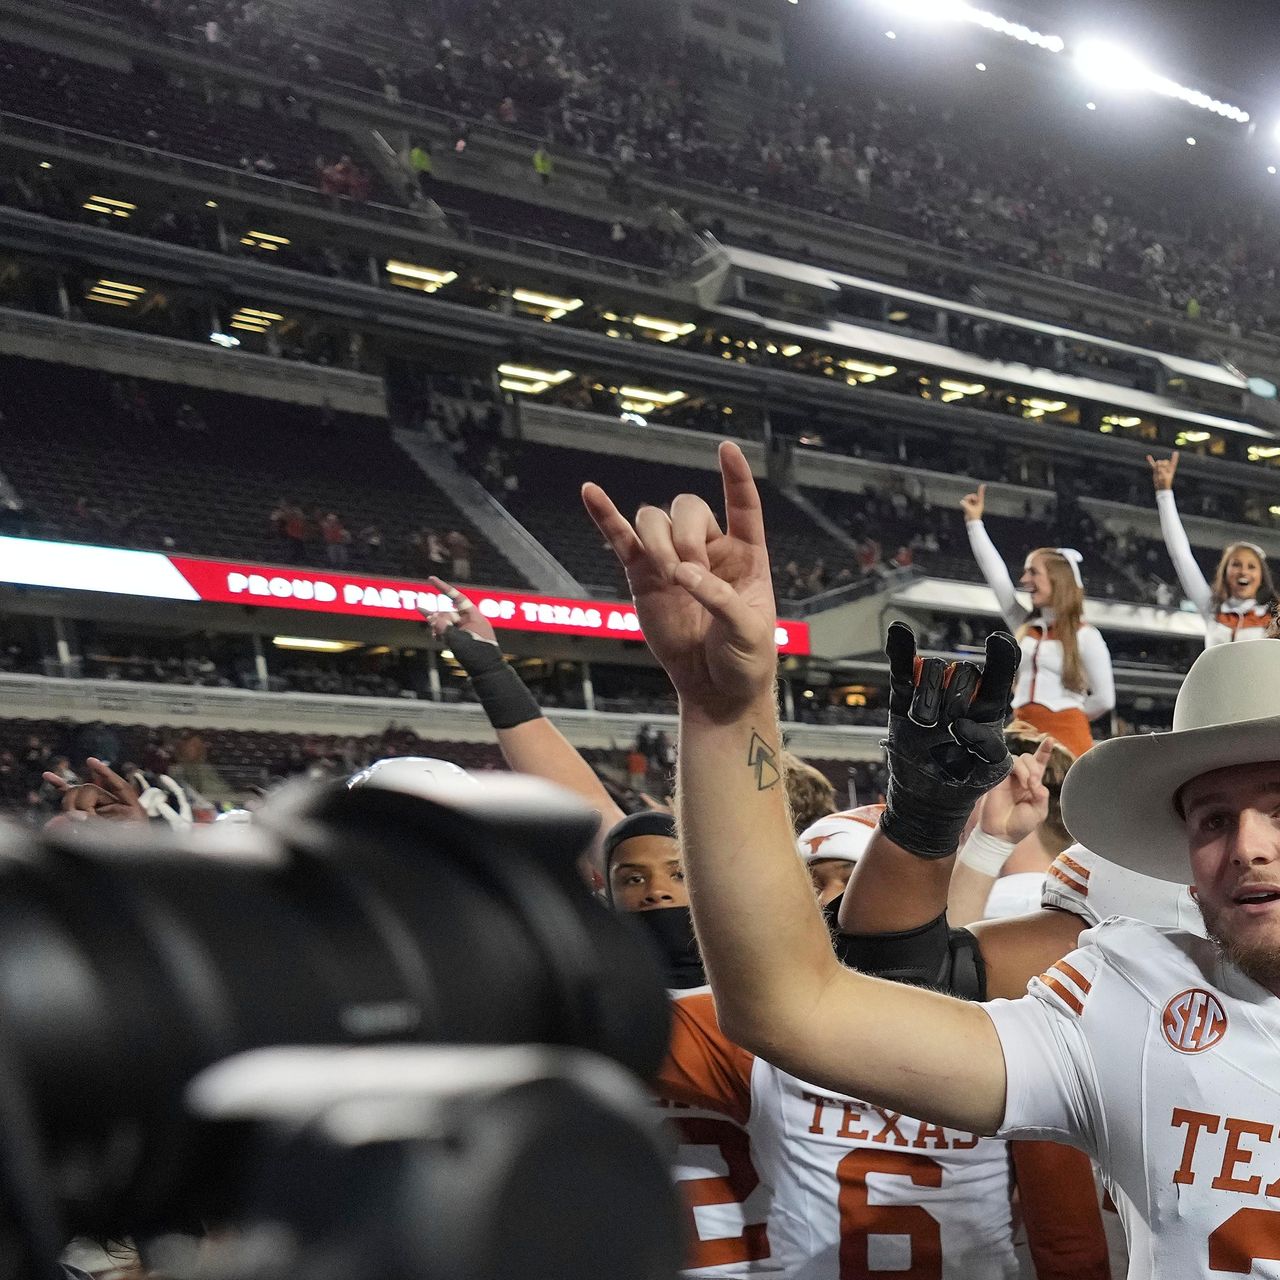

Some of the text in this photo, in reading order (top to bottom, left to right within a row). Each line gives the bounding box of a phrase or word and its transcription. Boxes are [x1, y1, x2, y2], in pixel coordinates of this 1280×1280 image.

[227, 572, 337, 602] PROUD
[343, 584, 456, 612] PARTNE
[478, 598, 516, 619] OF
[520, 601, 602, 628] TEXAS
[1163, 988, 1228, 1054] SEC
